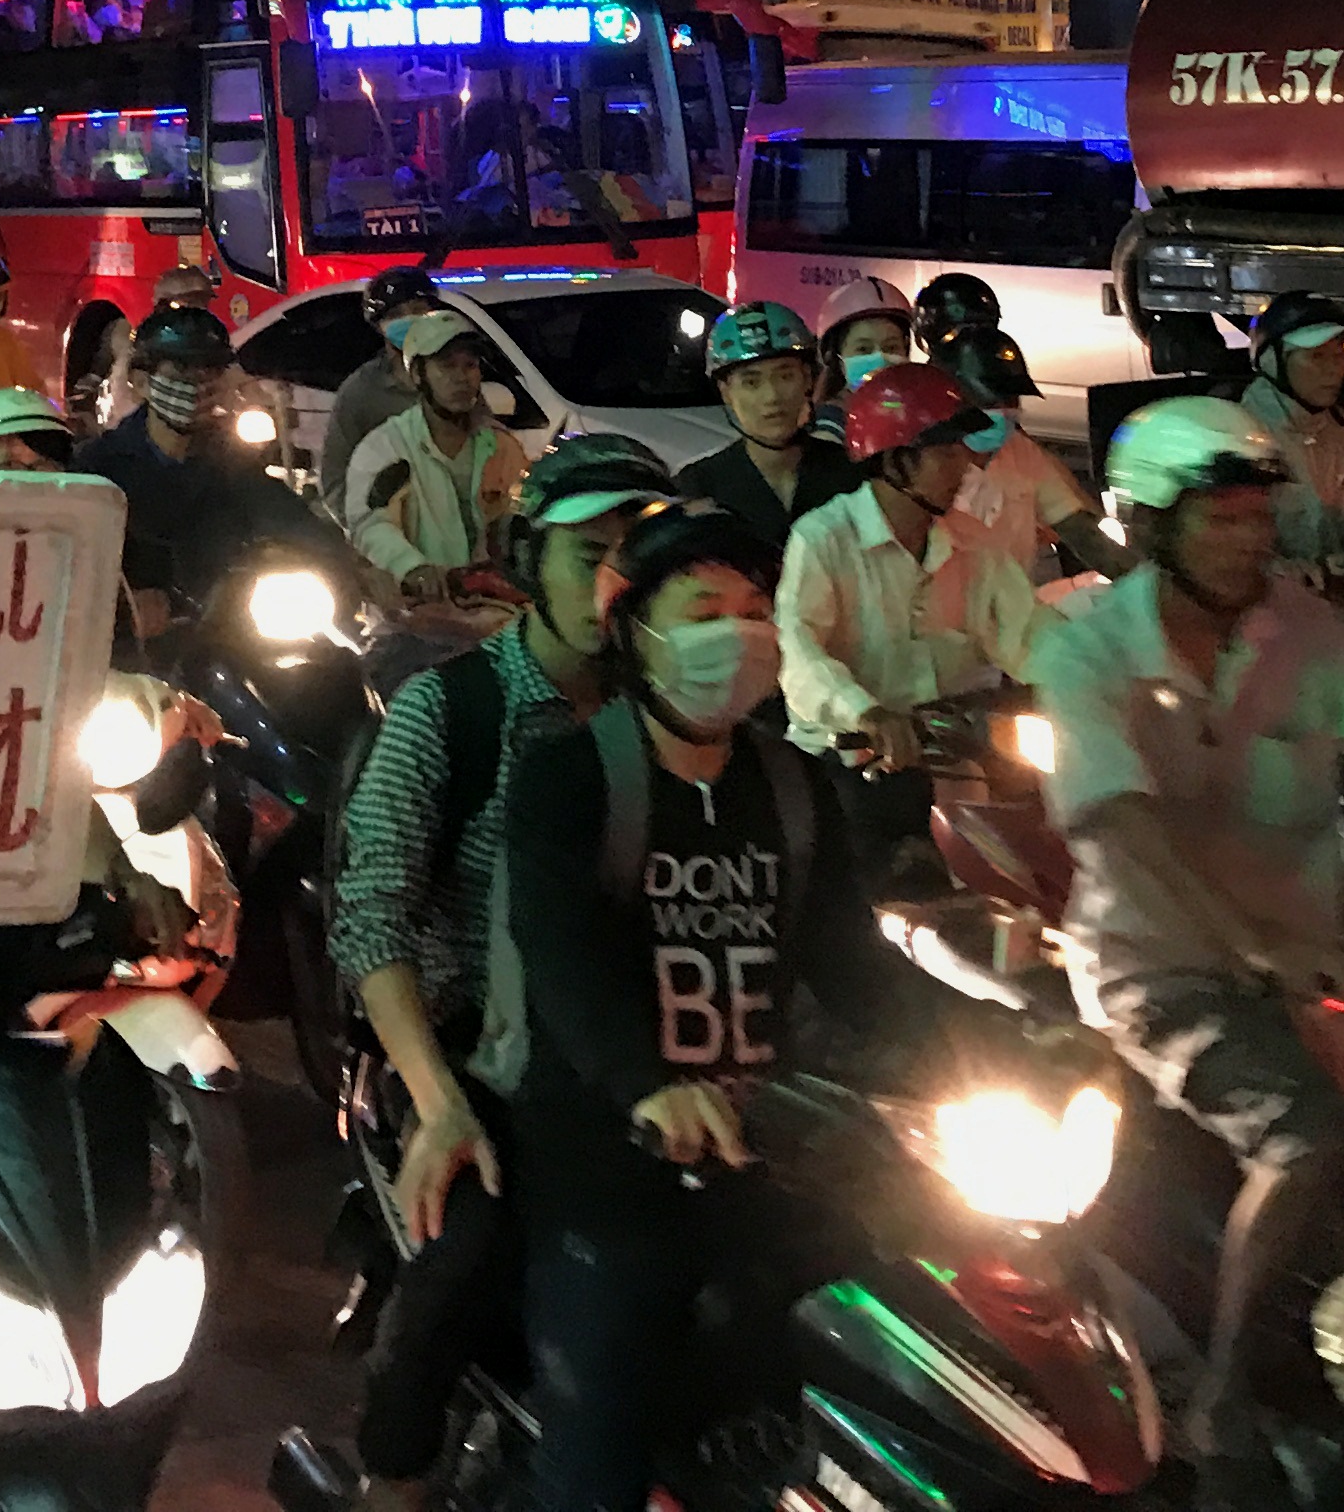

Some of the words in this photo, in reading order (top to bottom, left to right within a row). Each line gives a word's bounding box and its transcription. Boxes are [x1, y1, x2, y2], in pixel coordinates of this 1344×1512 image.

[408, 218, 420, 233] 1
[643, 841, 780, 902] DON'T
[652, 901, 777, 939] WORK
[654, 944, 778, 1065] BE
